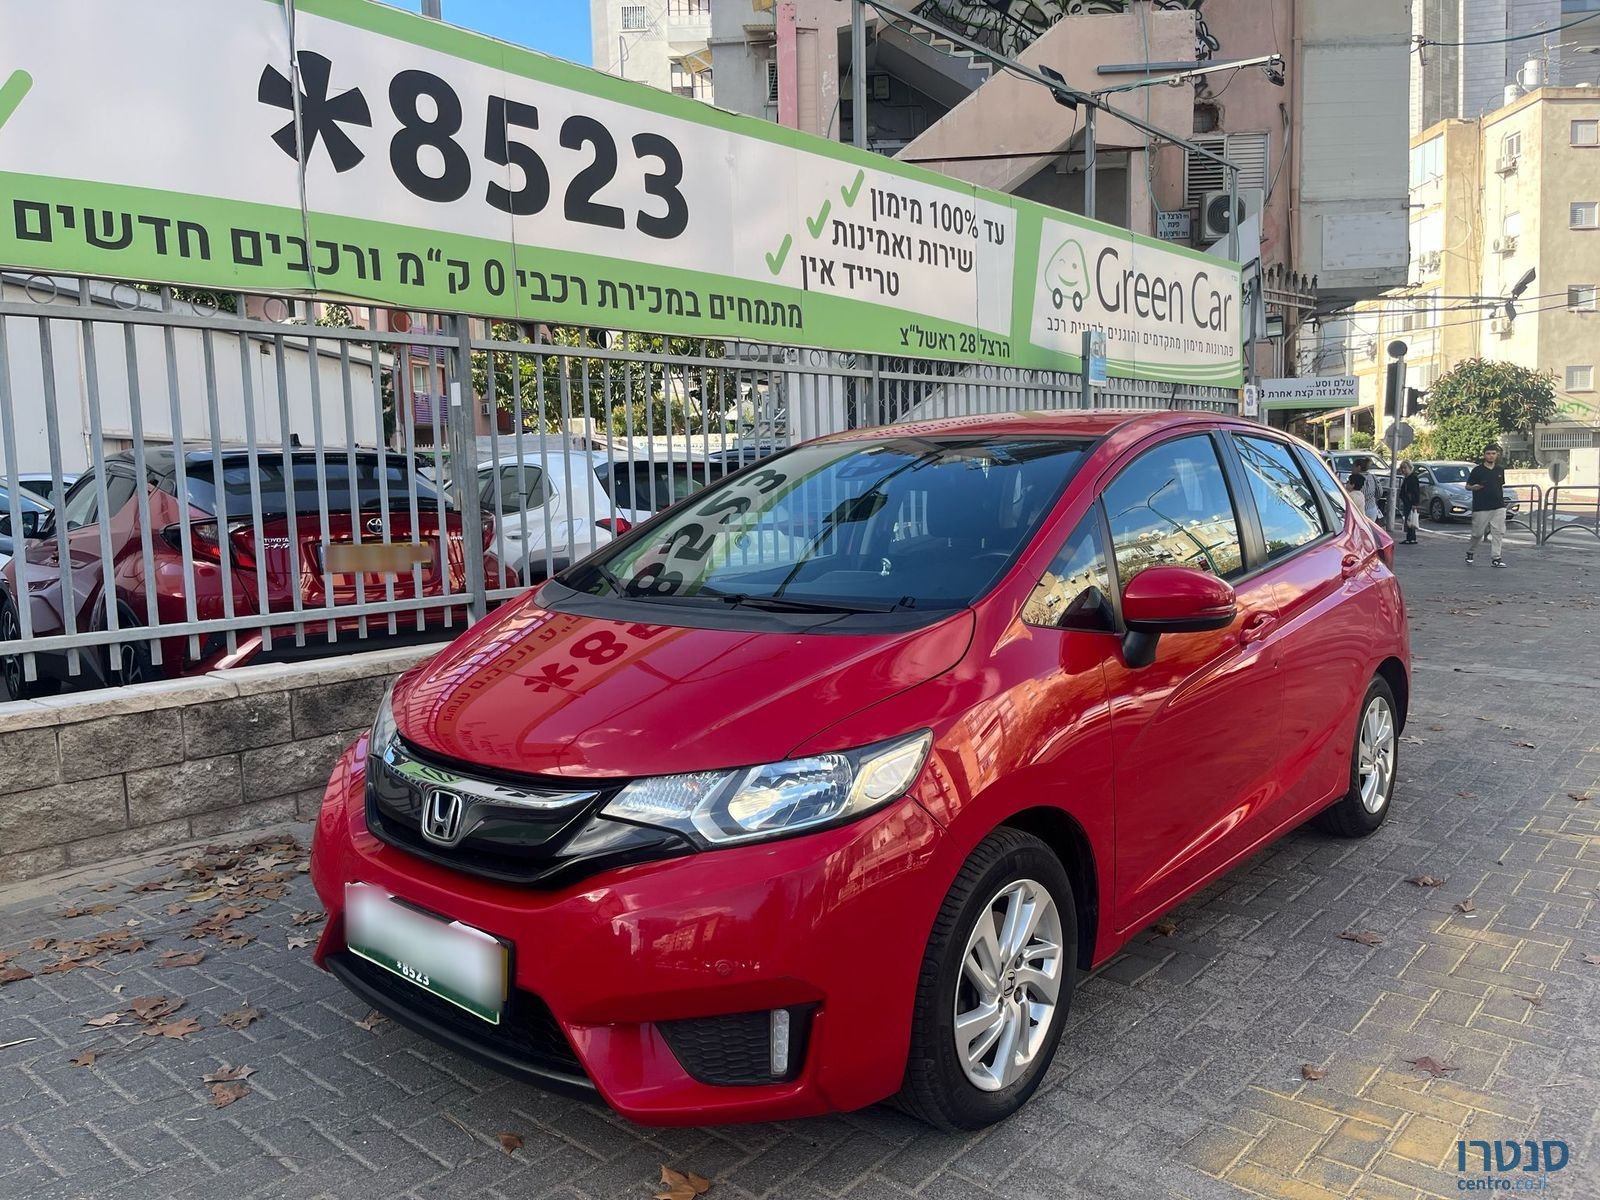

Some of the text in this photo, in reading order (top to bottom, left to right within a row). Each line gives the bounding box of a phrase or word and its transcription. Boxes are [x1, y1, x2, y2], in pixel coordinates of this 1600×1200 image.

[870, 187, 1005, 245] עד 100% מימון
[13, 199, 211, 261] חדשים
[230, 227, 382, 282] ורכבים
[832, 219, 973, 273] שירות ואמינות
[484, 258, 505, 297] 0
[800, 254, 900, 296] טרייד אין
[516, 269, 588, 306] רכבי
[597, 278, 702, 318] במכירת
[1095, 246, 1232, 333] Green Car
[708, 293, 803, 329] מתמחים
[1047, 316, 1067, 334] רכב
[1108, 326, 1140, 344] והוגנים
[959, 332, 976, 354] 28
[980, 333, 1010, 358] הרצל
[1143, 331, 1181, 350] מתקדמים
[1183, 338, 1203, 354] מימון
[1205, 341, 1234, 357] פתרונות
[1295, 389, 1313, 399] קצת
[1316, 388, 1326, 396] זה
[1329, 387, 1354, 396] אצלנו
[1333, 378, 1355, 387] שלם
[1267, 390, 1292, 399] אחרת
